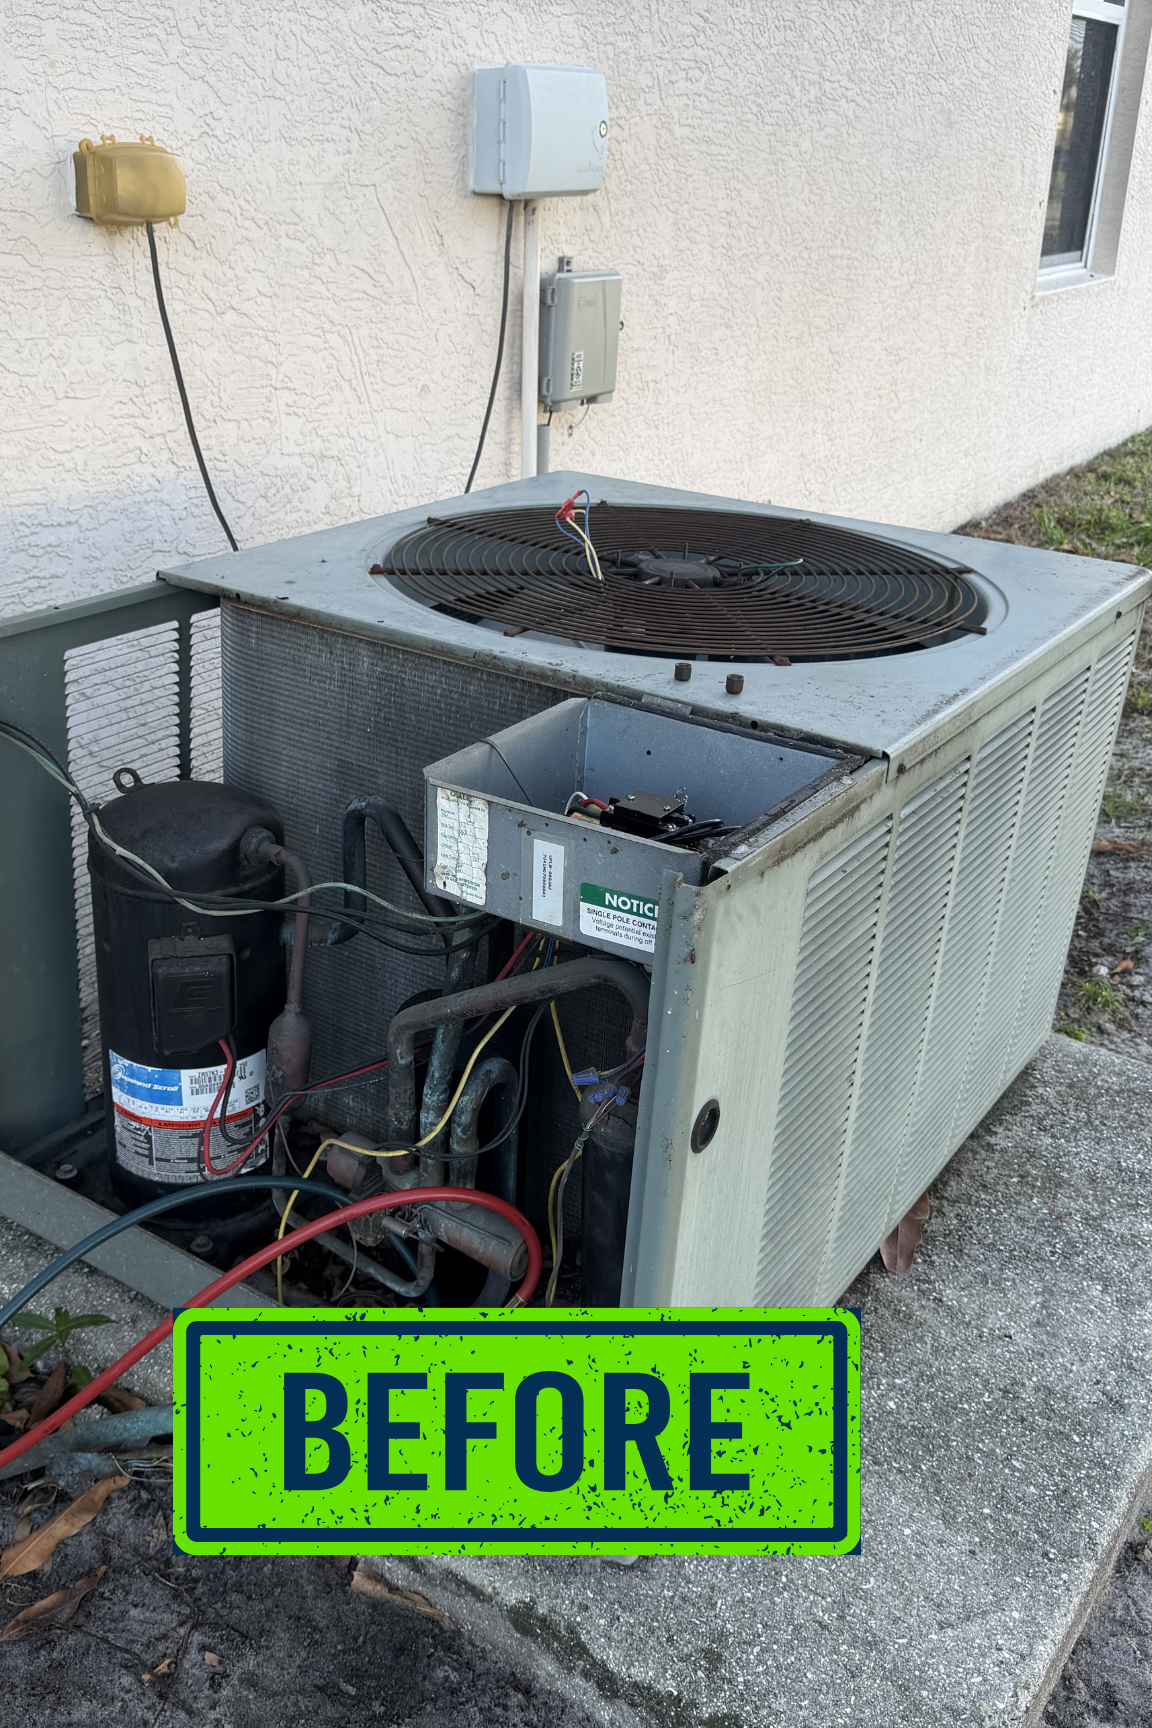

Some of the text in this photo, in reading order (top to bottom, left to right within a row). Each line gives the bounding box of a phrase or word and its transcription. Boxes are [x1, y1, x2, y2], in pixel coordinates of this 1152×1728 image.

[586, 908, 611, 920] SINGLE
[612, 914, 630, 925] POLE
[592, 917, 614, 929] Voltage
[615, 924, 641, 936] potential
[595, 925, 623, 938] terminals
[624, 932, 643, 945] during
[152, 1084, 179, 1092] Scroll
